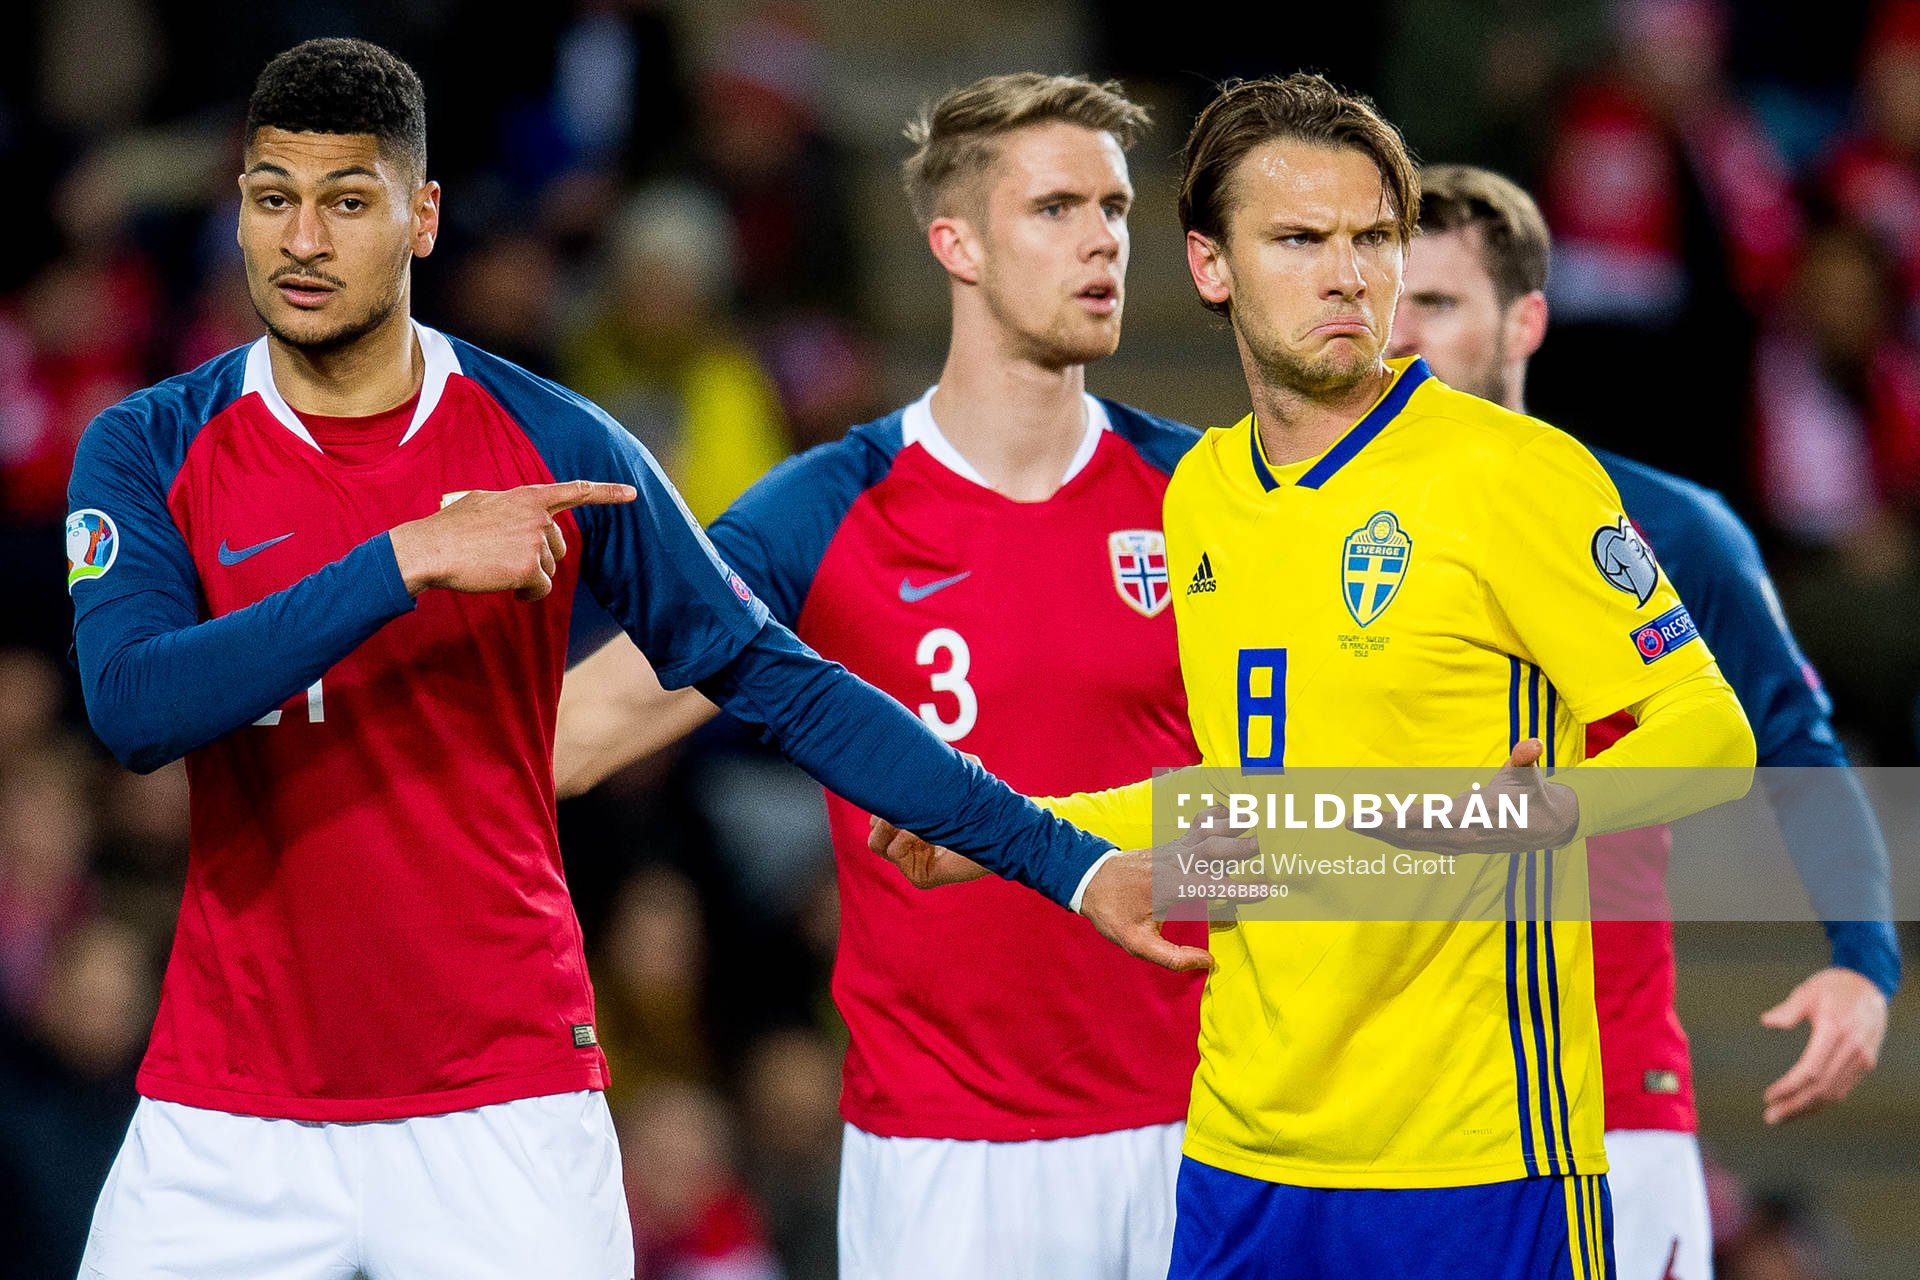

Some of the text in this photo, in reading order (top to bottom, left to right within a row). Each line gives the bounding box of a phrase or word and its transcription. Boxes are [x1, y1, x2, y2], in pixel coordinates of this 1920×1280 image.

[1356, 545, 1400, 556] SVERIGE
[1187, 579, 1216, 595] adidas
[916, 628, 978, 742] 3
[1237, 648, 1287, 776] 8
